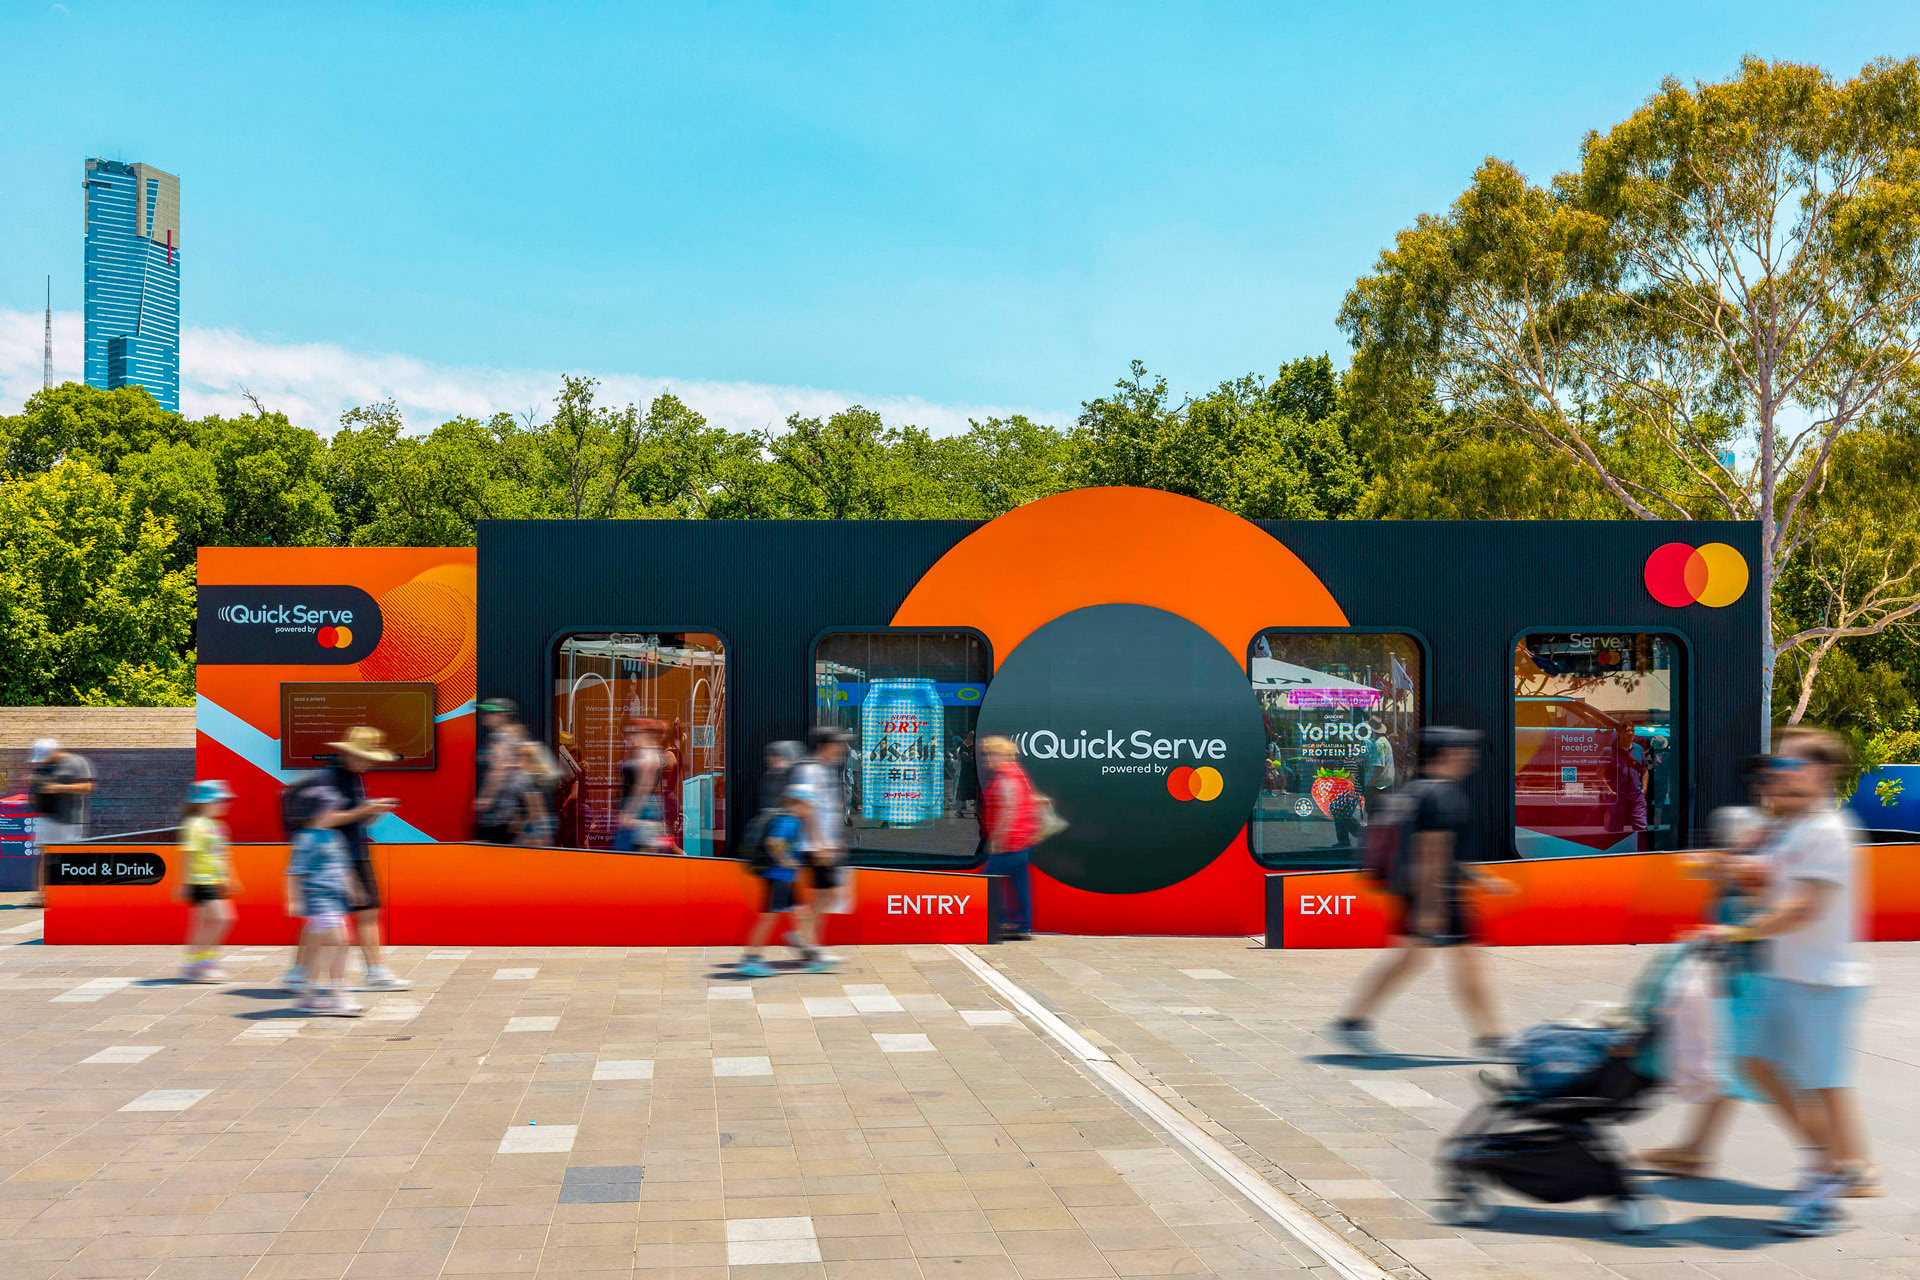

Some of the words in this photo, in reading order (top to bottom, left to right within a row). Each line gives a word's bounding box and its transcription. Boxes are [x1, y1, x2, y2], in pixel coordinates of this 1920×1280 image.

[275, 625, 306, 634] powered
[308, 625, 317, 634] by
[1569, 633, 1621, 649] Serve
[1297, 722, 1372, 741] YoPRO
[1561, 734, 1585, 743] Need
[870, 735, 936, 762] Asahi
[1302, 748, 1346, 756] PROTEIN
[1561, 743, 1599, 753] receipt?
[887, 768, 916, 780] 辛口
[1101, 763, 1151, 775] powered
[1154, 763, 1168, 775] by
[61, 862, 97, 876] Food
[101, 863, 112, 876] &
[116, 862, 154, 876] Drink
[887, 894, 971, 915] ENTRY
[1300, 895, 1357, 915] EXIT
